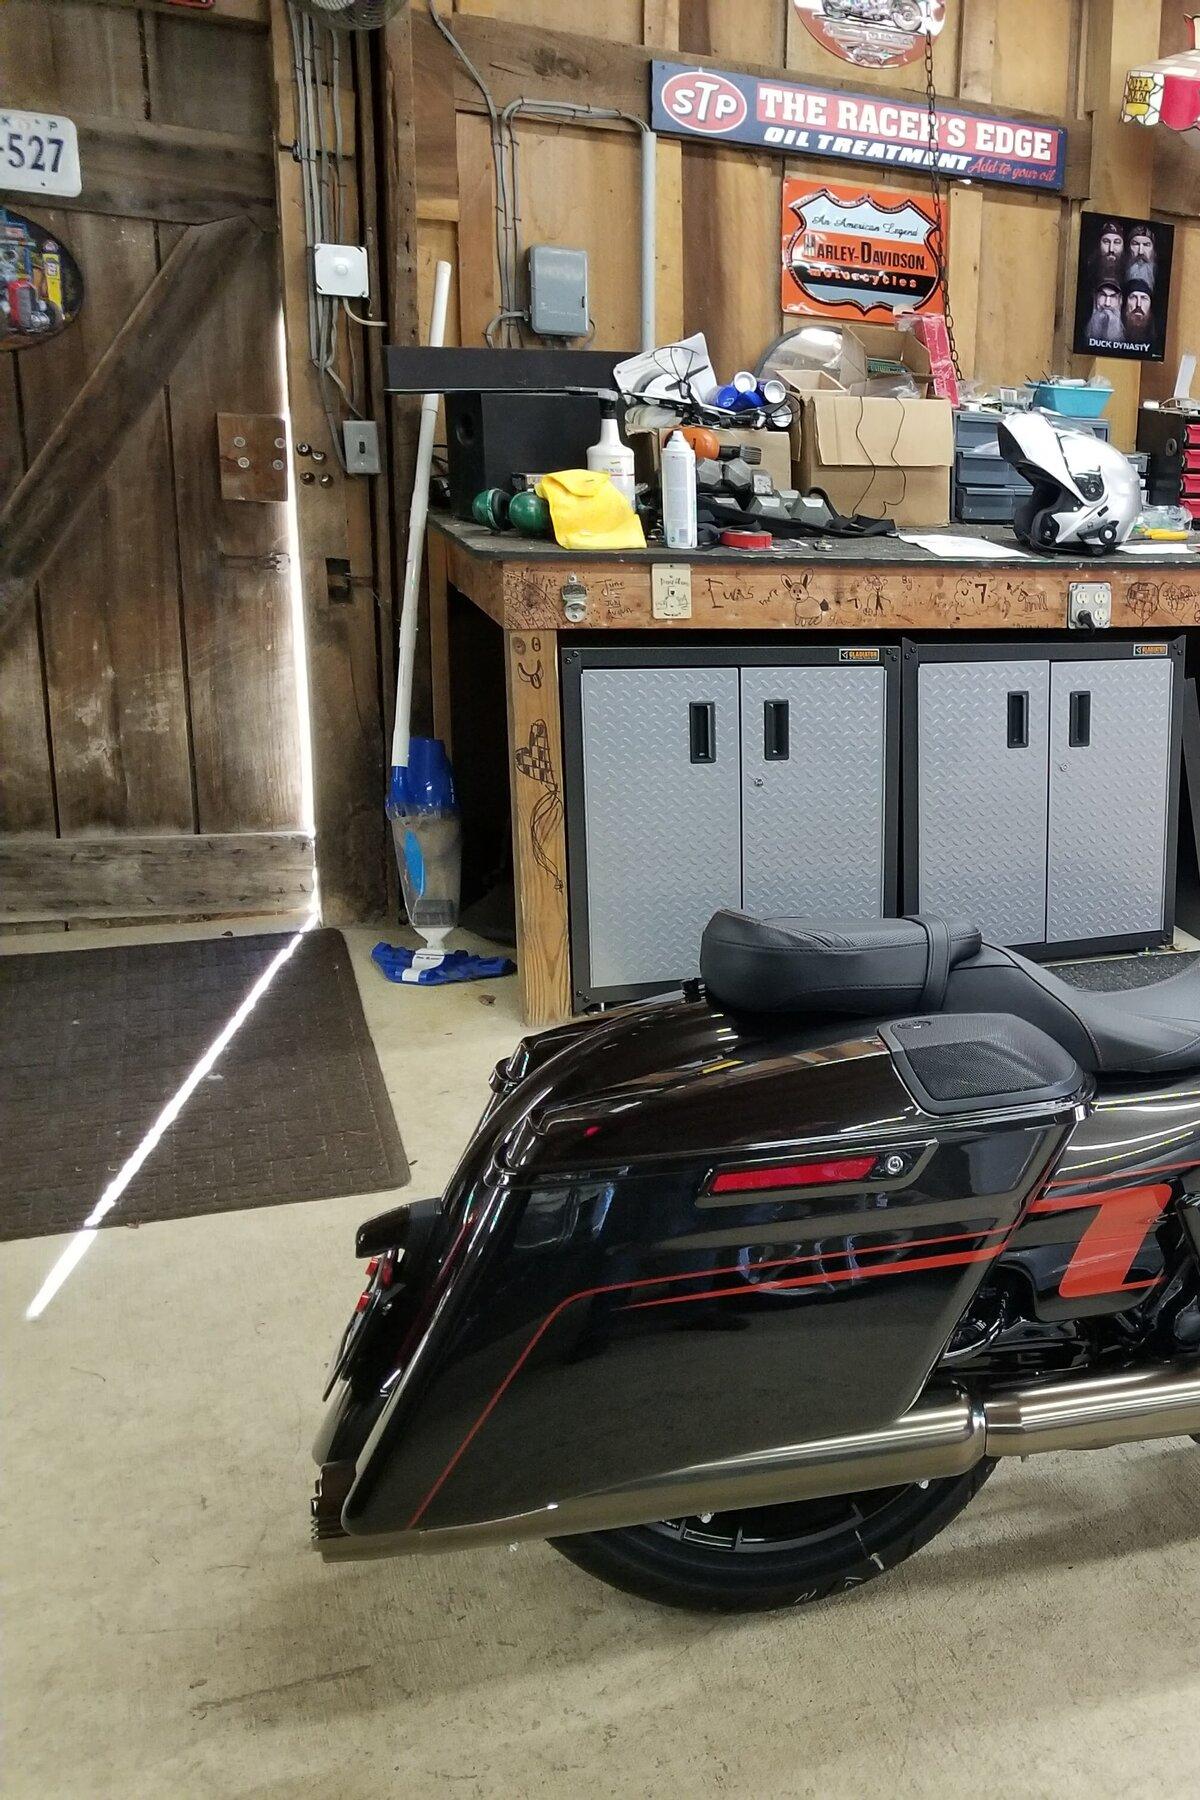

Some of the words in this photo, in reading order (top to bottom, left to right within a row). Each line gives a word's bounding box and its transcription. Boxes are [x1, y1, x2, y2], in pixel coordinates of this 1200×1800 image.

[672, 81, 737, 122] STP
[759, 88, 828, 126] THE
[837, 99, 966, 148] RACER'S
[975, 122, 1052, 161] EDGE
[763, 127, 810, 148] OIL
[817, 134, 972, 170] TREATMENT
[967, 156, 996, 174] Add
[997, 163, 1012, 175] to
[1012, 168, 1038, 181] your
[1039, 169, 1057, 182] oil
[812, 215, 830, 226] An
[834, 218, 880, 232] American
[882, 223, 919, 239] Legend
[1089, 338, 1112, 349] DUCK
[1113, 341, 1151, 352] DYNASTY
[705, 578, 723, 609] I
[723, 585, 755, 601] was
